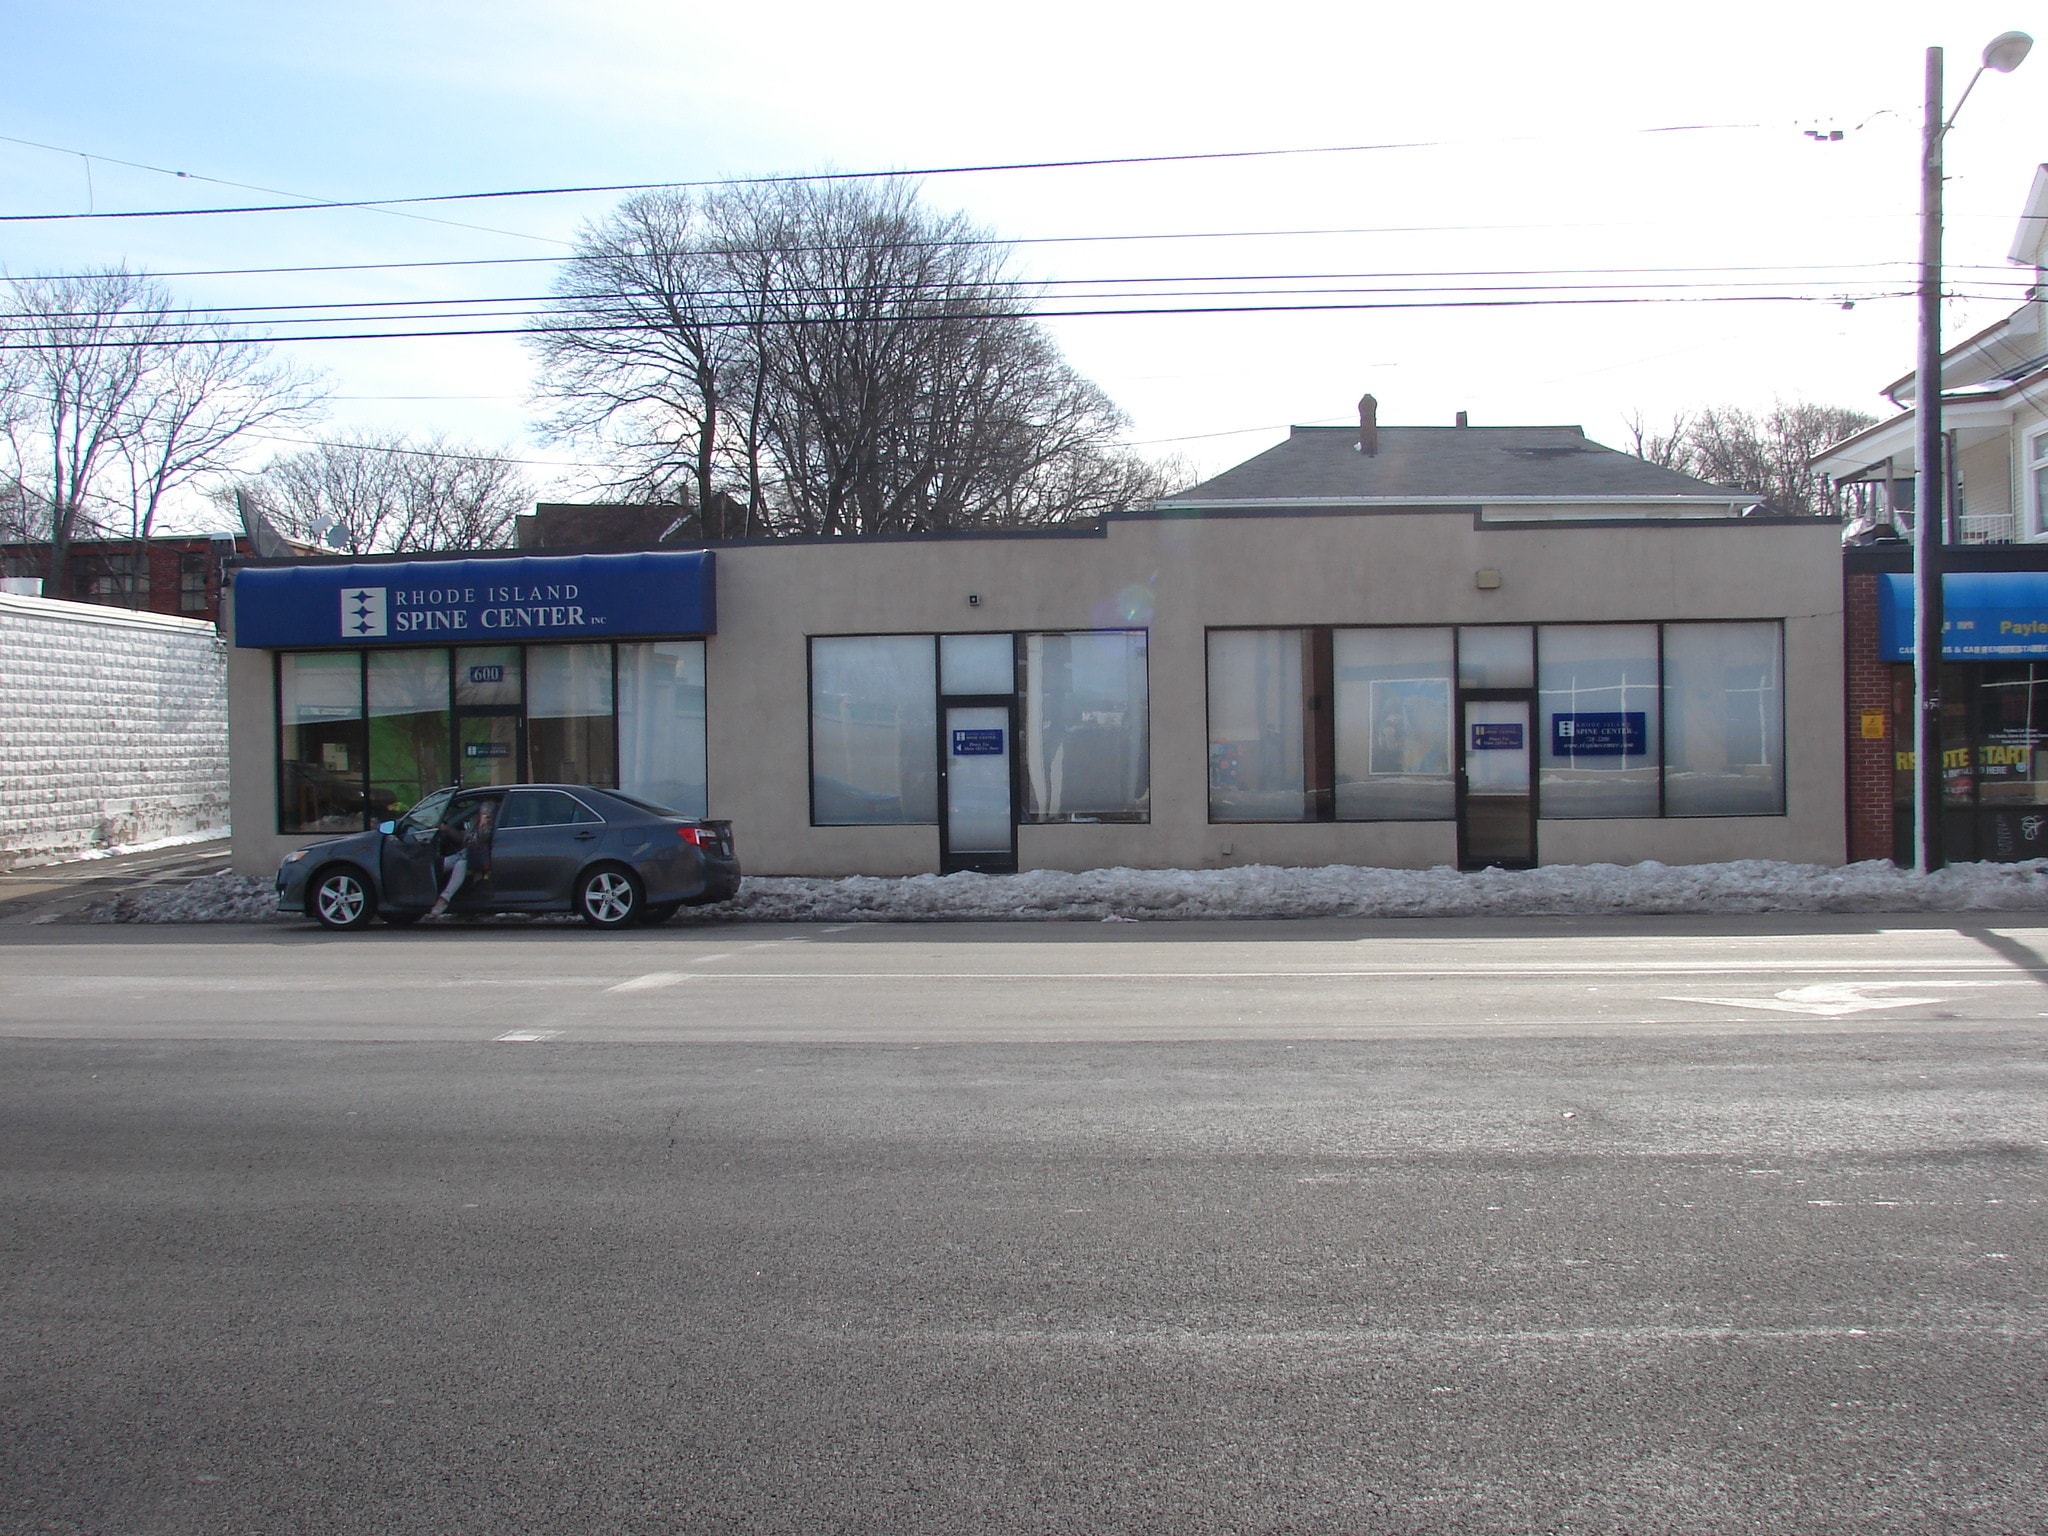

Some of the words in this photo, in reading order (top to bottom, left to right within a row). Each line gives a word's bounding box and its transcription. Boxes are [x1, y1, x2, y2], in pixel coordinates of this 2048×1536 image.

[396, 588, 476, 606] RHODE
[489, 584, 579, 602] ISLAND
[396, 609, 468, 631] SPINE
[480, 606, 586, 628] CENTER
[591, 616, 607, 625] INC
[474, 667, 499, 681] 600
